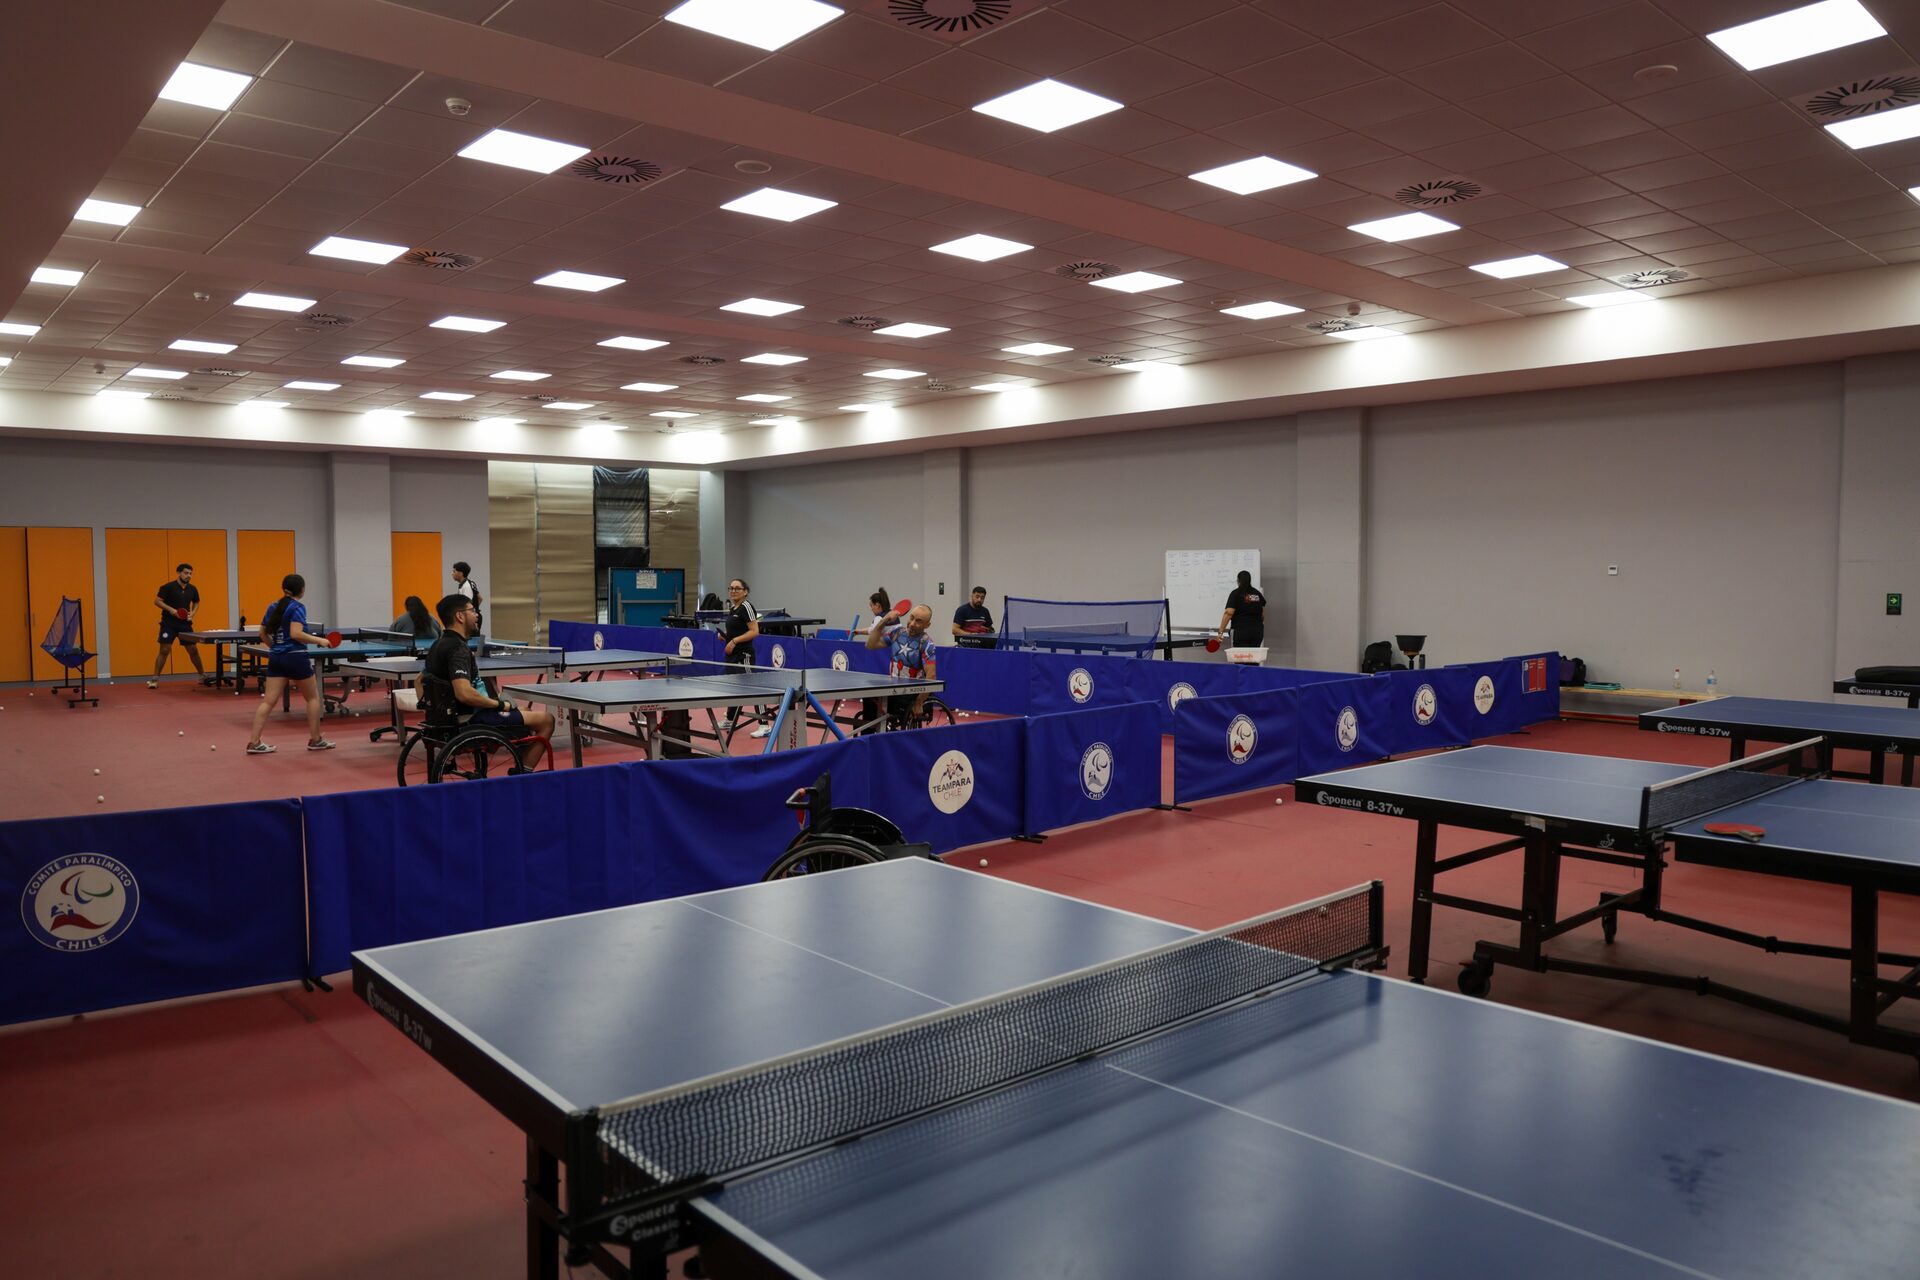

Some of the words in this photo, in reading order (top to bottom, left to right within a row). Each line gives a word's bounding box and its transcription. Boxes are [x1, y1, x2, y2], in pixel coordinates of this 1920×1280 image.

[1849, 686, 1881, 695] Sponeta
[1884, 689, 1911, 697] 8-37w
[1657, 721, 1696, 733] Sponeta
[1699, 728, 1730, 737] 8-37w
[932, 777, 972, 794] TEAMPARA
[943, 788, 962, 800] CHILE
[1317, 790, 1362, 808] Sponeta
[1367, 800, 1404, 815] 8-37w
[65, 856, 131, 887] PARALÍMPICO
[56, 934, 108, 951] CHILE
[403, 1014, 433, 1050] 8-37w
[610, 1203, 677, 1236] Sponeta
[632, 1218, 680, 1242] Classic
